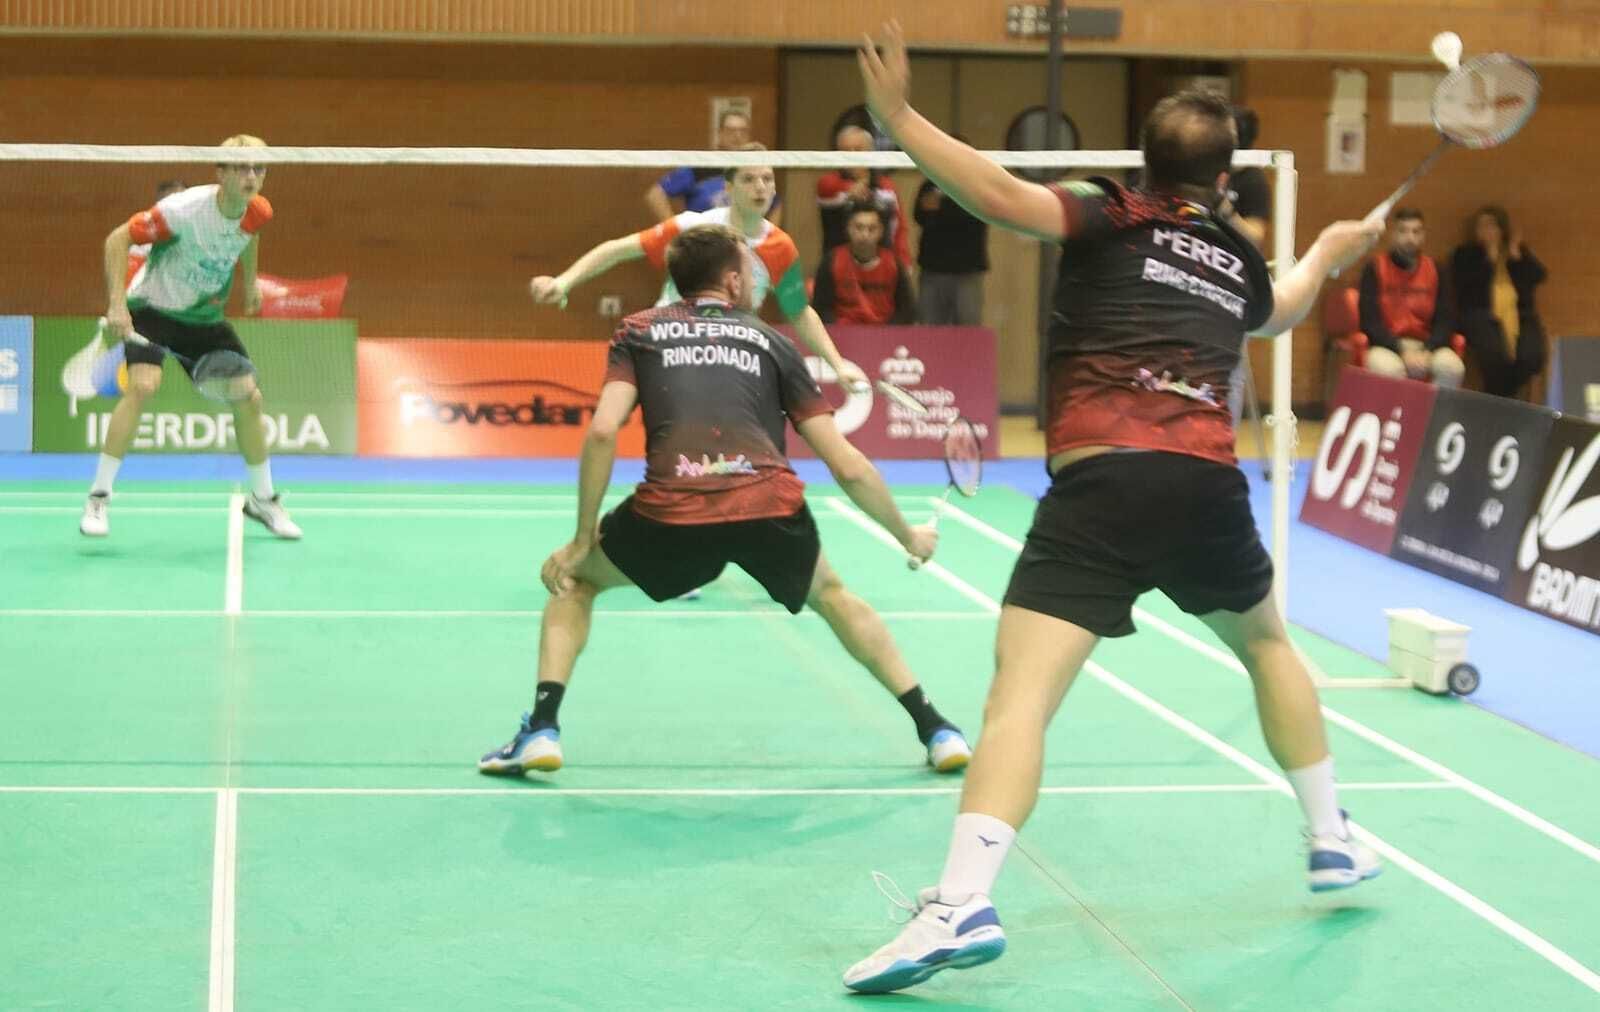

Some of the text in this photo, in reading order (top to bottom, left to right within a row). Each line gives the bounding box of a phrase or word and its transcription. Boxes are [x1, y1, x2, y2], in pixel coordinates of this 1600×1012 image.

[650, 322, 770, 351] WOLFENDEN
[662, 345, 761, 377] RINCONADA
[87, 412, 329, 448] IERDRLA
